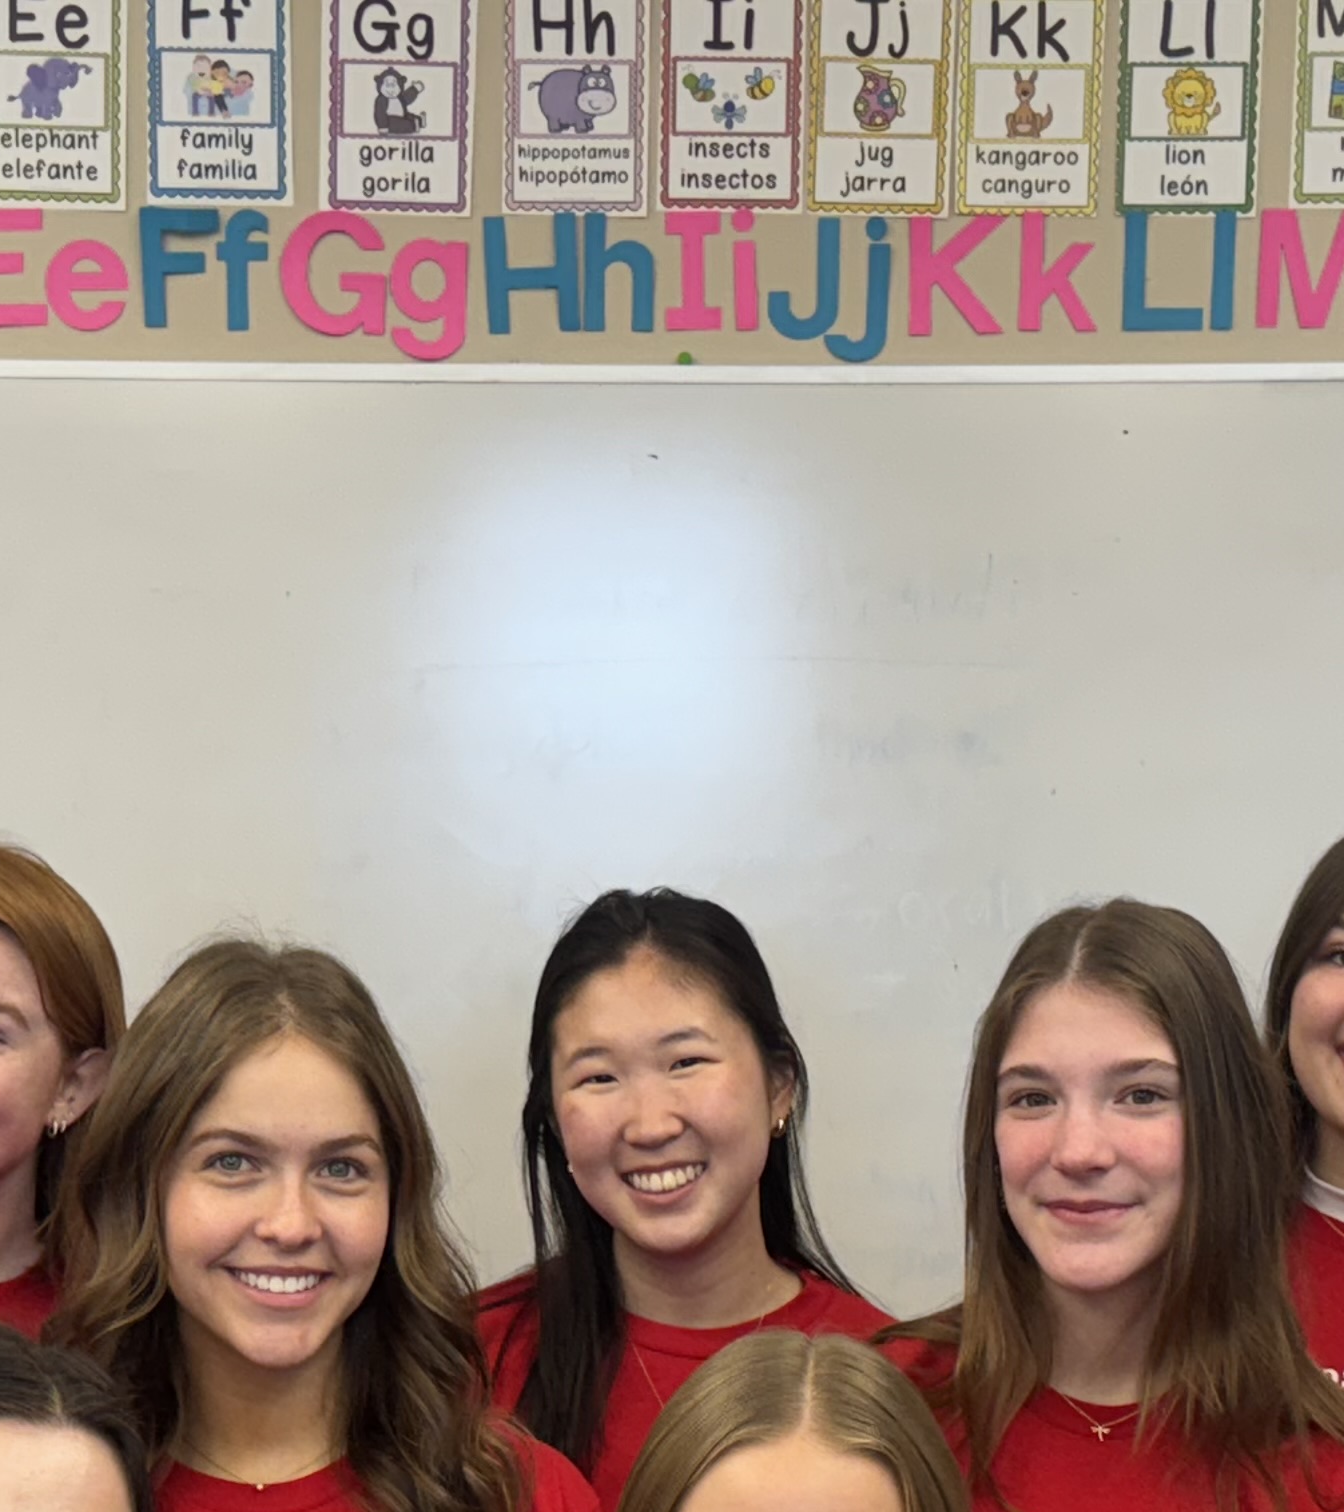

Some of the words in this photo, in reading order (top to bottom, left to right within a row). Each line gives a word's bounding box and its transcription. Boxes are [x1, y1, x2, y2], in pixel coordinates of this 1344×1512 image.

[9, 0, 89, 49] Ee
[182, 0, 251, 42] Ff
[353, 0, 434, 60] Gg
[533, 0, 615, 57] Hh
[704, 0, 754, 51] Ii
[846, 0, 909, 57] Jj
[991, 0, 1069, 61] Kk
[1160, 0, 1216, 60] Ll
[1, 130, 99, 152] elephant
[180, 128, 253, 156] family
[360, 140, 434, 167] gorilla
[517, 144, 630, 162] hippopotamus
[689, 139, 770, 159] insects
[855, 142, 893, 167] jug
[976, 146, 1078, 170] kangaroo
[1166, 144, 1205, 165] lion
[2, 158, 97, 181] elefante
[177, 159, 257, 180] familia
[519, 166, 628, 186] hipopótamo
[681, 169, 776, 189] insectos
[363, 172, 430, 197] gorila
[839, 172, 906, 197] jarra
[981, 175, 1071, 197] canguro
[1161, 175, 1208, 196] león
[141, 208, 266, 329] Ff
[282, 210, 467, 361] Gg
[486, 215, 652, 332] Hh
[666, 211, 757, 330] Ii
[770, 220, 889, 360] Jj
[910, 212, 1094, 335] Kk
[1125, 212, 1234, 329] Ll
